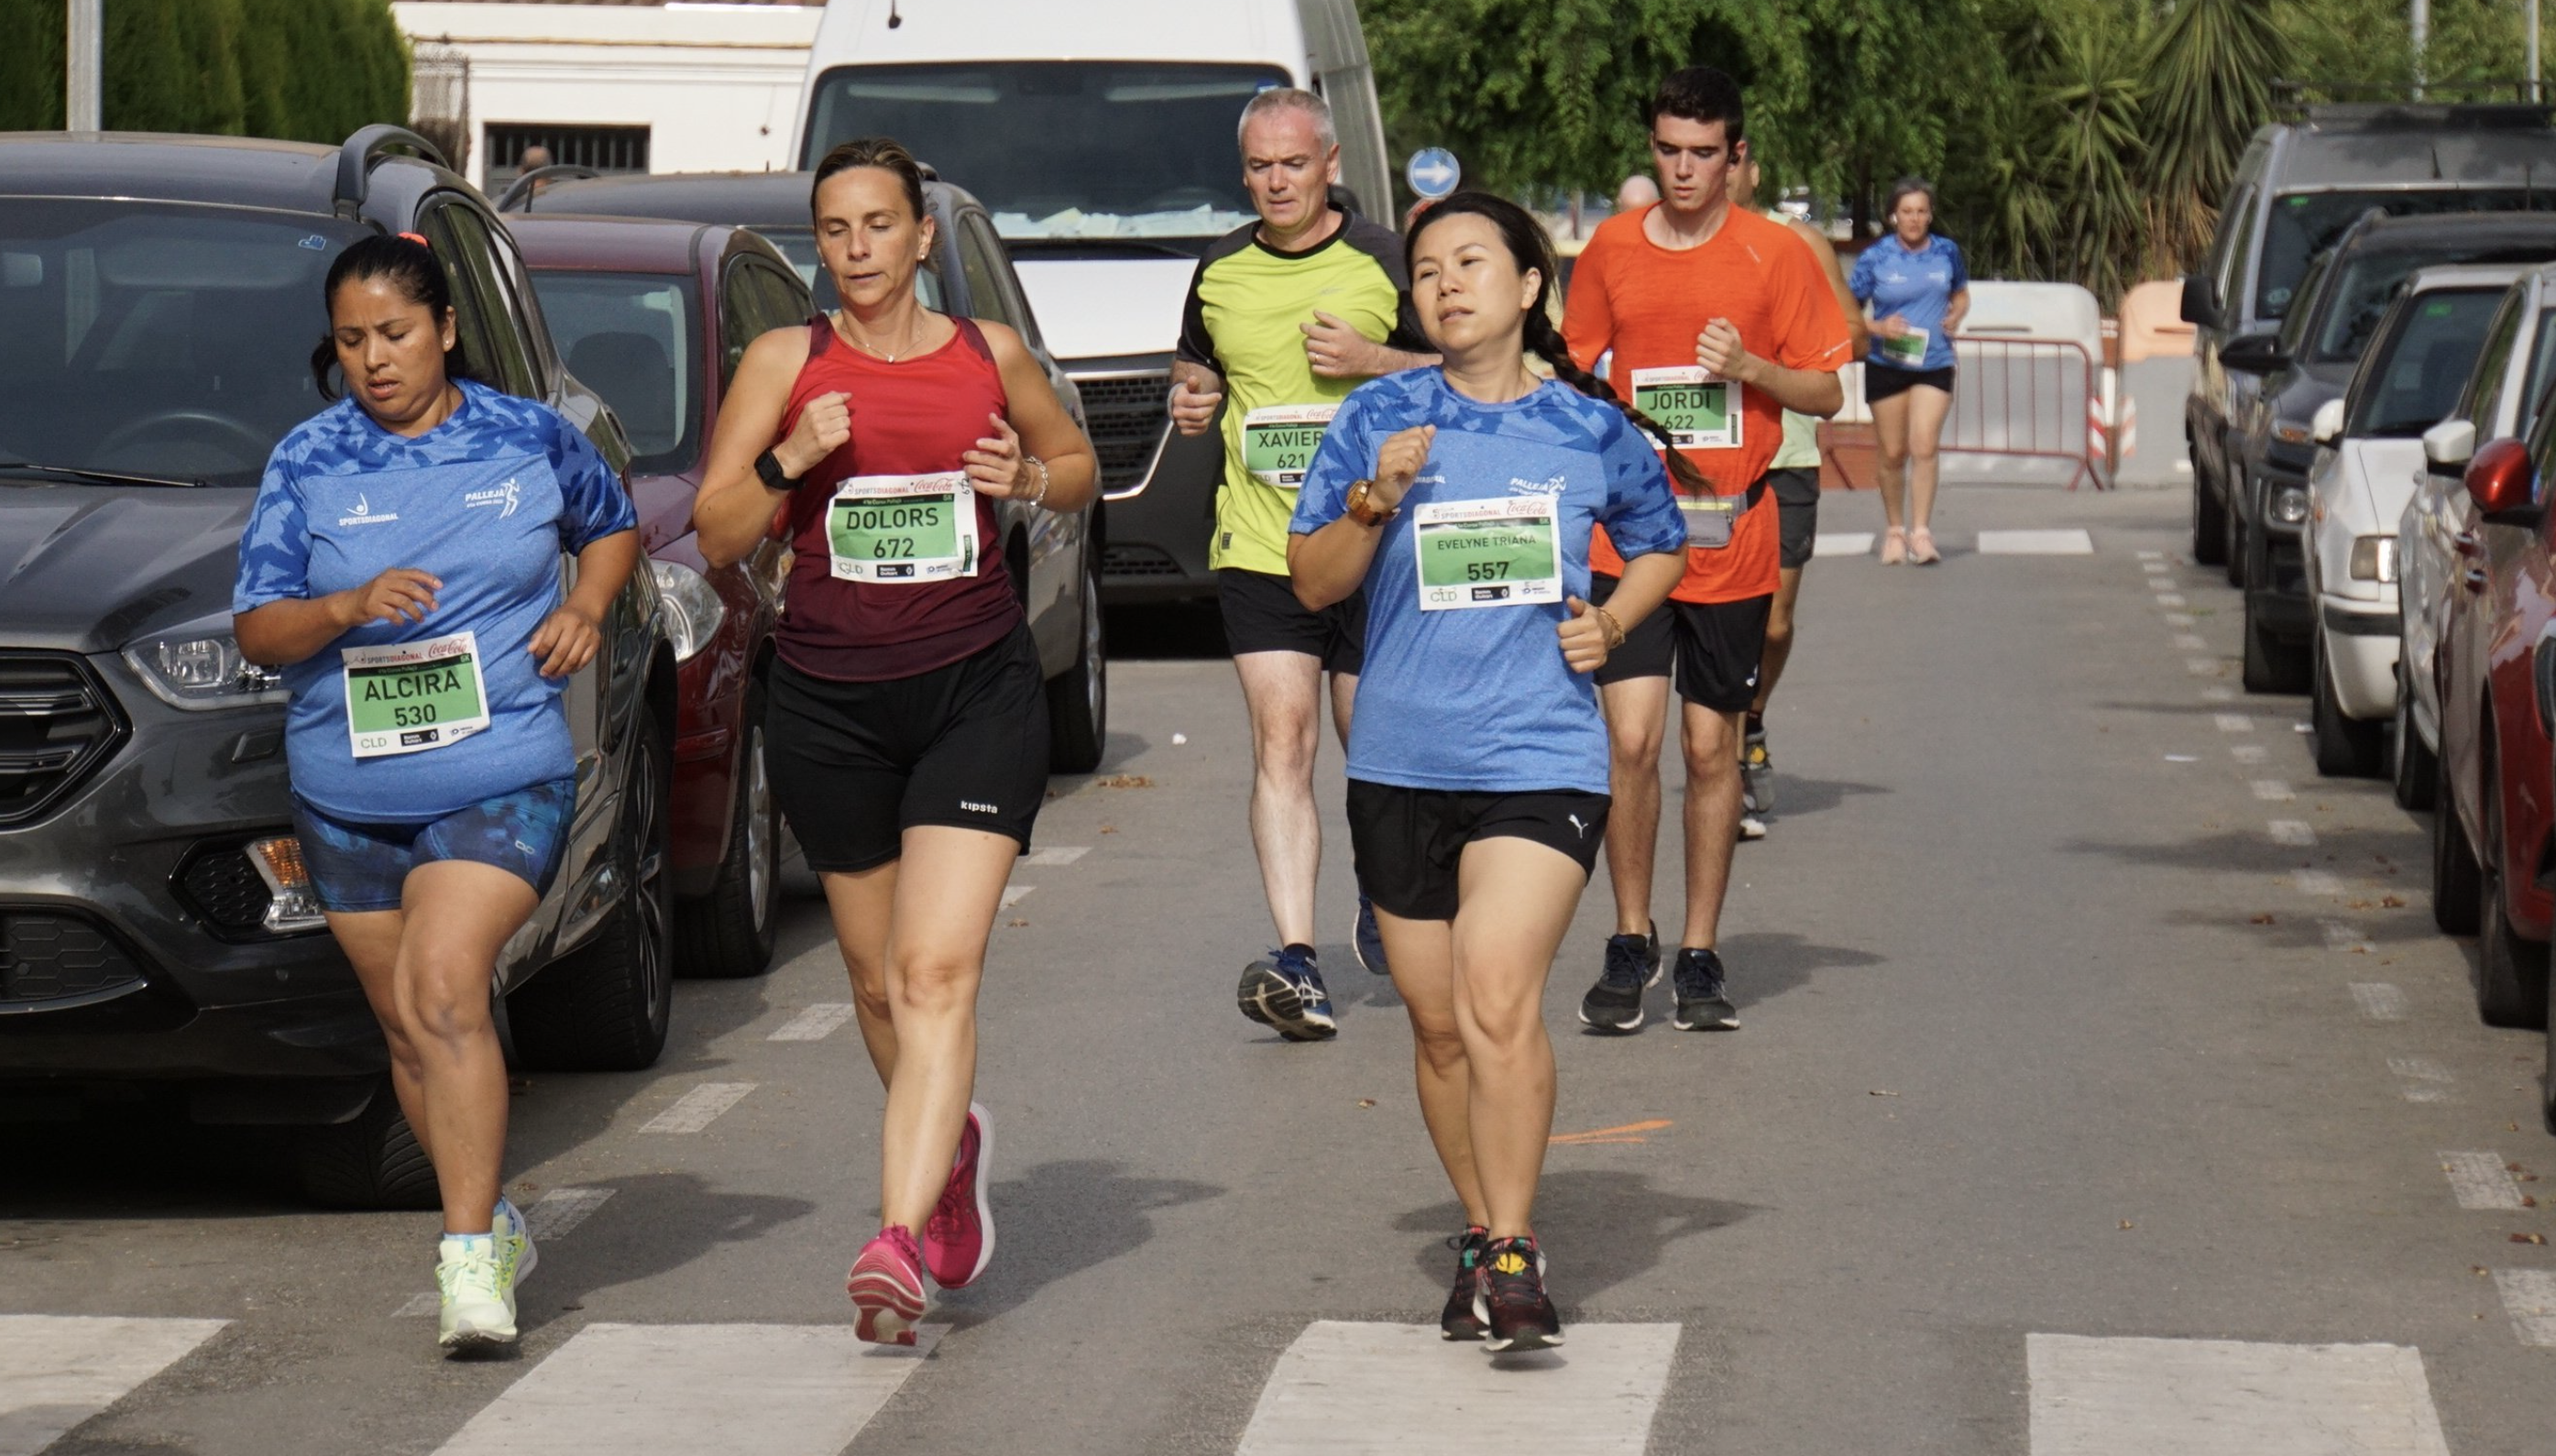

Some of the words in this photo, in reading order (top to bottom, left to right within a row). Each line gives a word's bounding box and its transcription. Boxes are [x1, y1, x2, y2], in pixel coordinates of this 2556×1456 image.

[1649, 390, 1711, 411] JORDI
[1663, 414, 1695, 430] 622
[1258, 431, 1324, 448] XAVIER
[1277, 453, 1306, 468] 621
[854, 487, 909, 496] SPORTSDIAGONAL
[338, 512, 399, 527] SPORTSDIAGONAL
[846, 507, 939, 530] DOLORS
[1441, 509, 1501, 520] SPORTSDIAGONAL
[873, 538, 915, 559] 672
[1437, 537, 1489, 551] EVELYNE
[1492, 535, 1537, 547] TRIANA
[1467, 561, 1510, 581] 557
[1430, 591, 1457, 602] CLD
[367, 651, 423, 664] SPORTSDIAGONAL
[364, 670, 462, 702] ALCIRA
[394, 704, 437, 728] 530
[360, 737, 388, 750] CLD
[960, 800, 998, 815] kipsta
